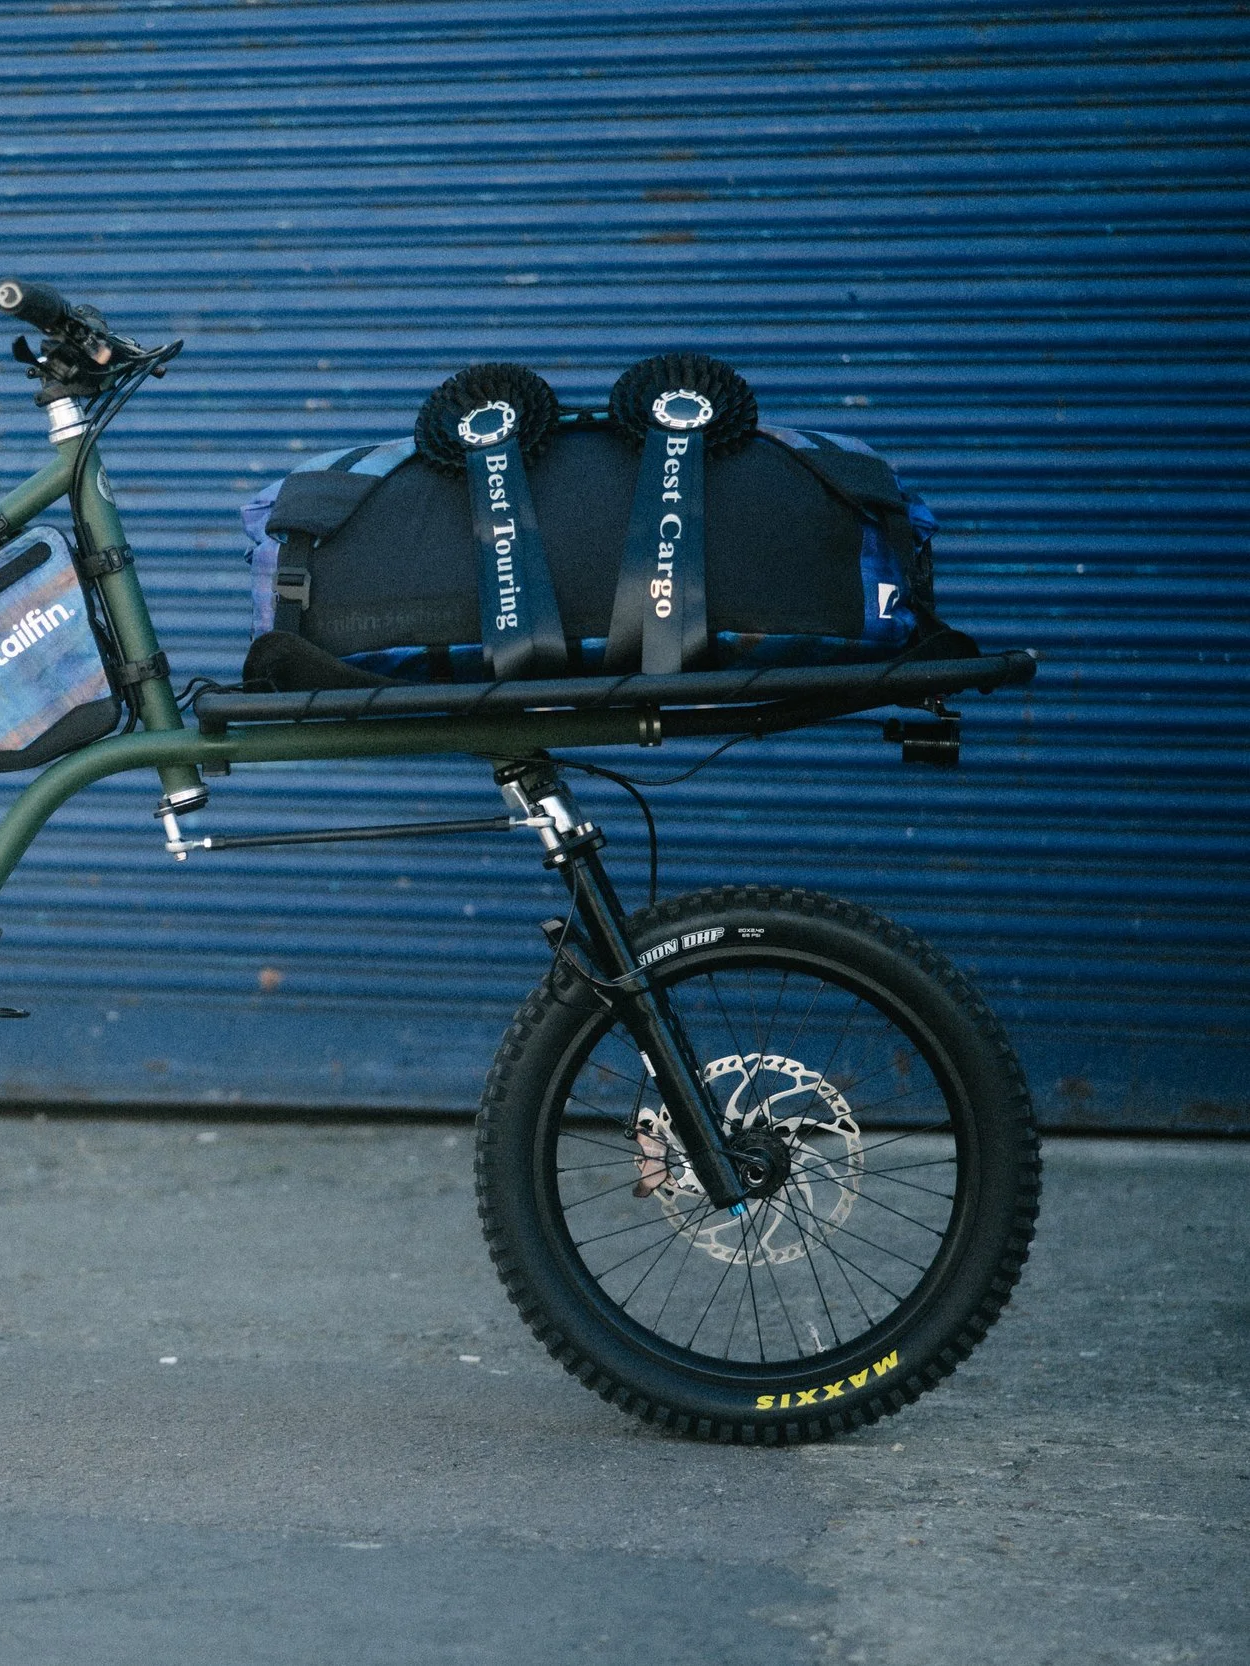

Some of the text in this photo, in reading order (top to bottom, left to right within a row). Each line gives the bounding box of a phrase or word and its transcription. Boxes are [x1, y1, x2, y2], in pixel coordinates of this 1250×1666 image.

[652, 388, 713, 428] BESPOKED
[485, 453, 521, 631] Best Touring
[650, 435, 688, 619] Best Cargo
[637, 926, 725, 966] NION DHF
[755, 1349, 899, 1410] MAXXIS
